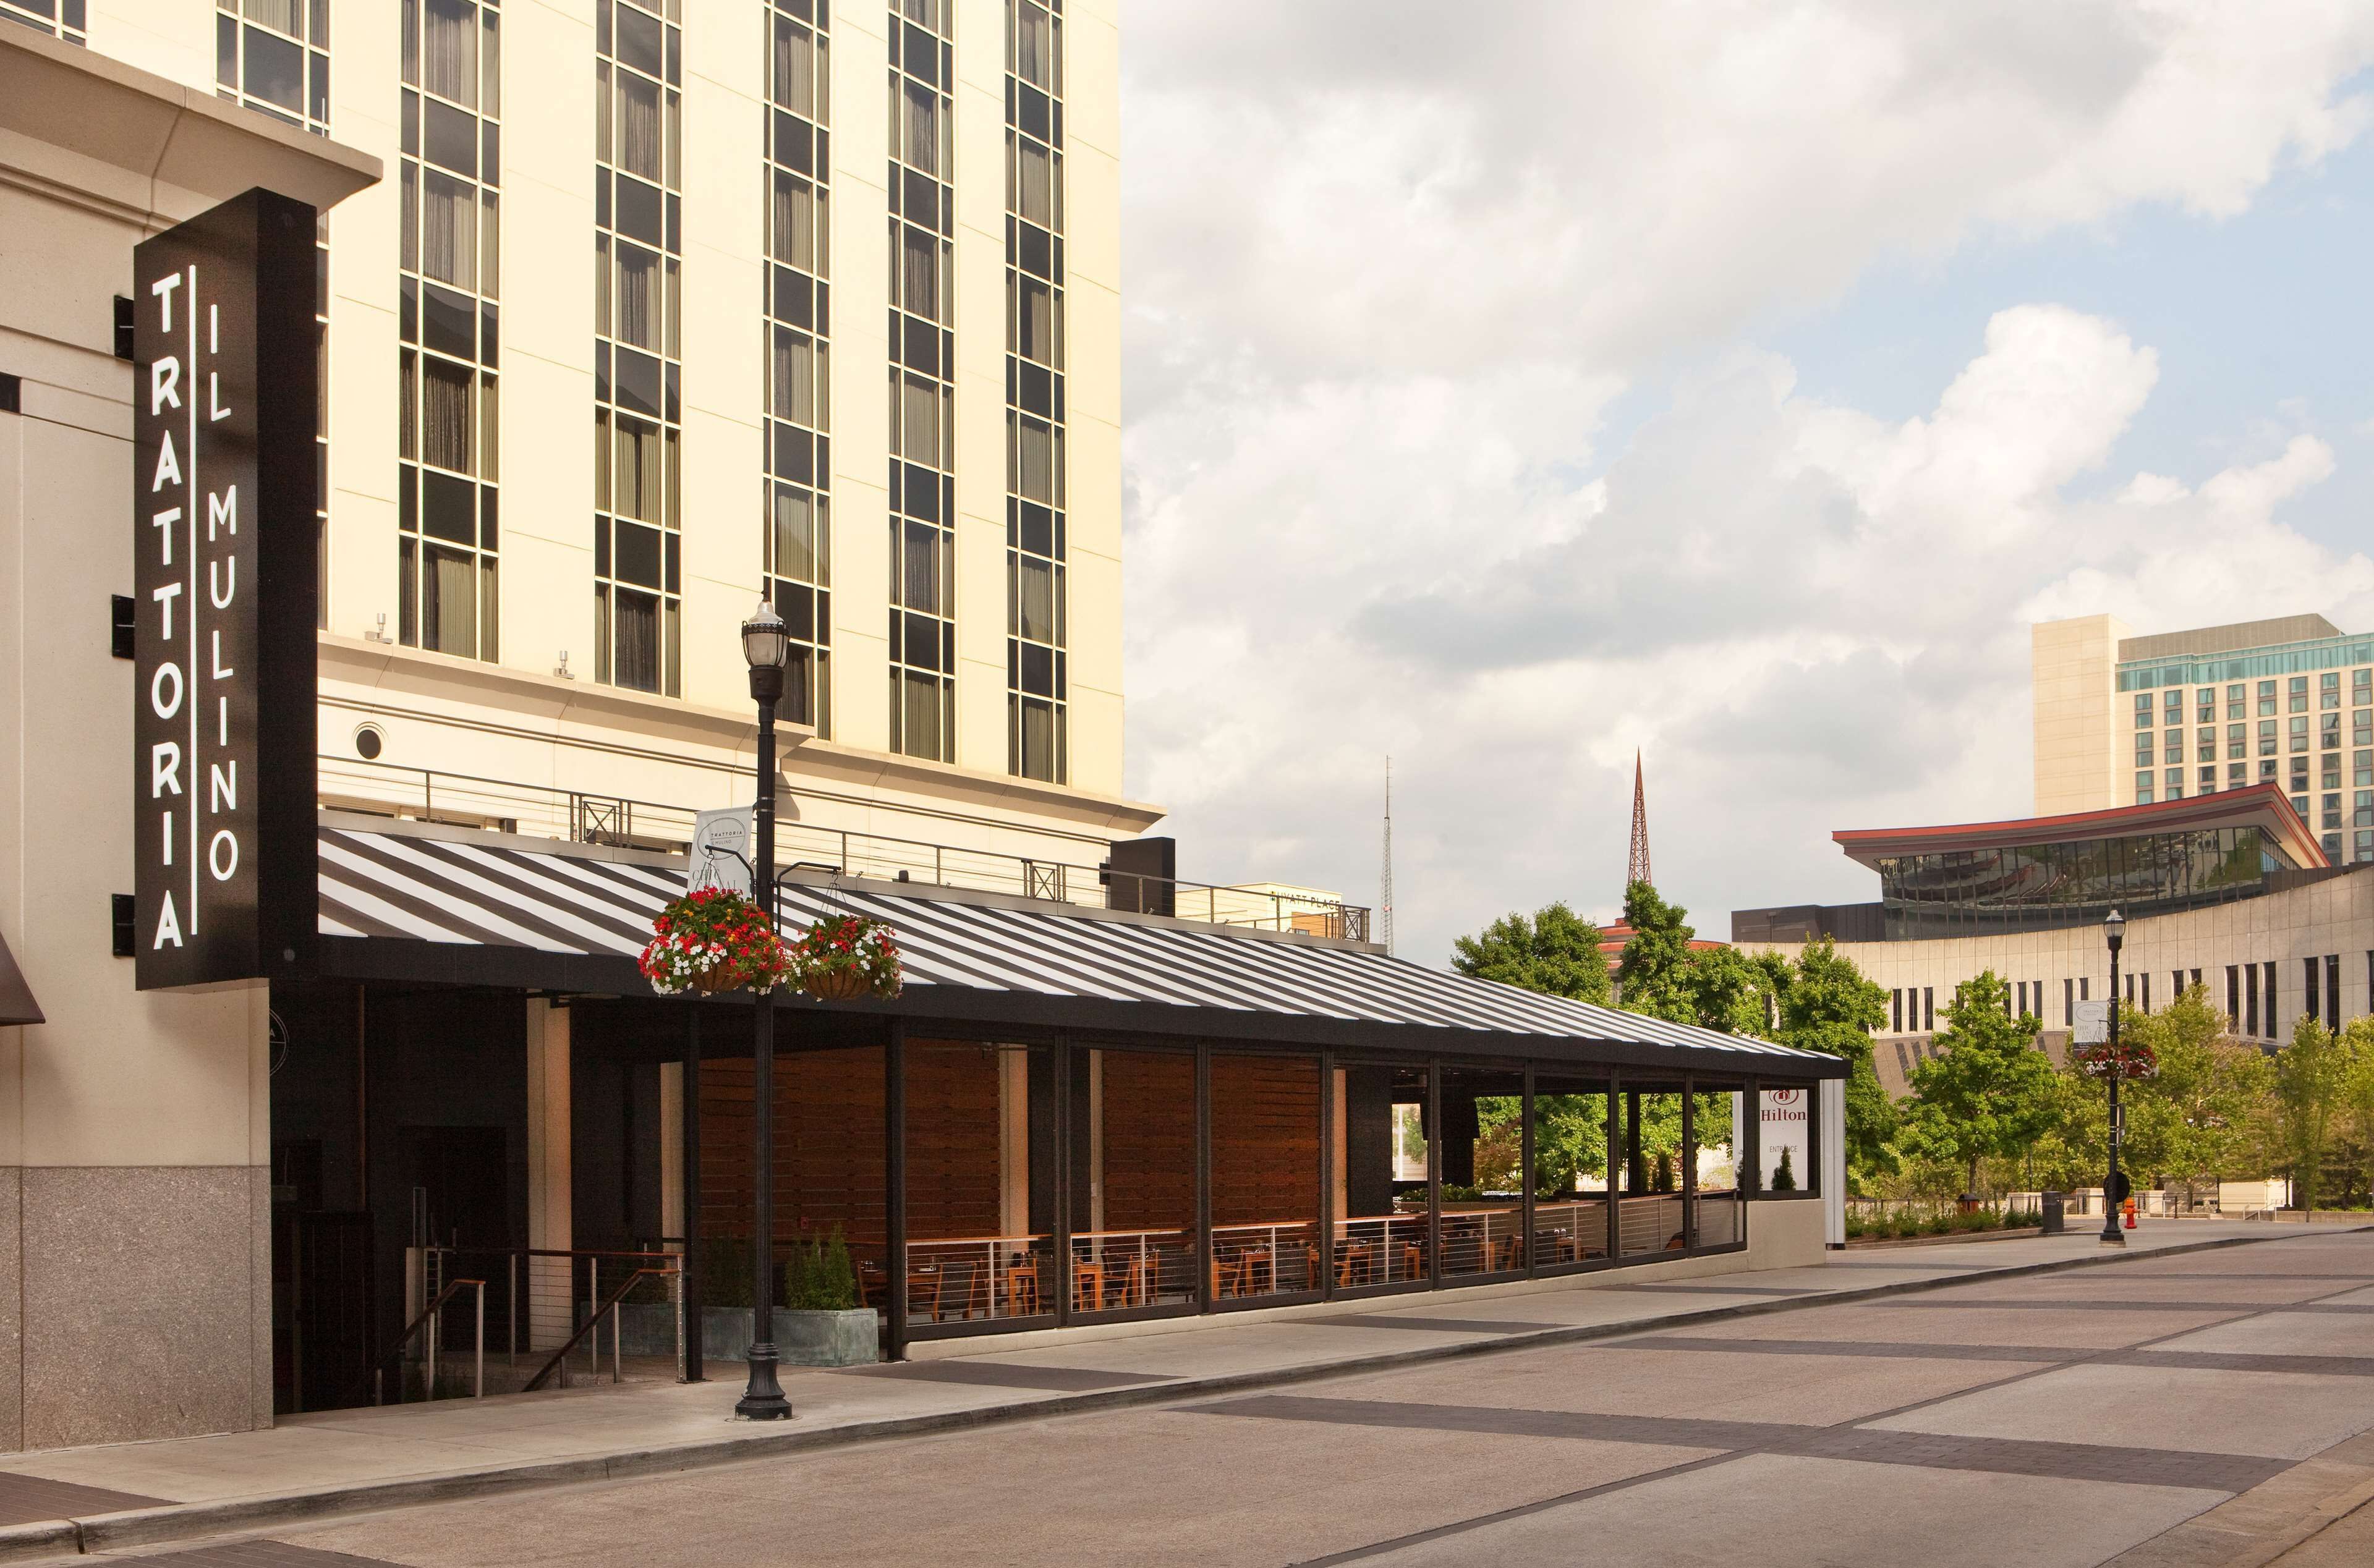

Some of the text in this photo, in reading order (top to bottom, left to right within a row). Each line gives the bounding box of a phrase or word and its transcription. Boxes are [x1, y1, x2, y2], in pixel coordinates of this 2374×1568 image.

[209, 303, 238, 881] IL MULINO
[151, 273, 184, 950] TRATTORIA
[692, 869, 720, 881] CHIC
[1277, 891, 1340, 910] HYATT PLACE
[1761, 1108, 1806, 1121] Hilton
